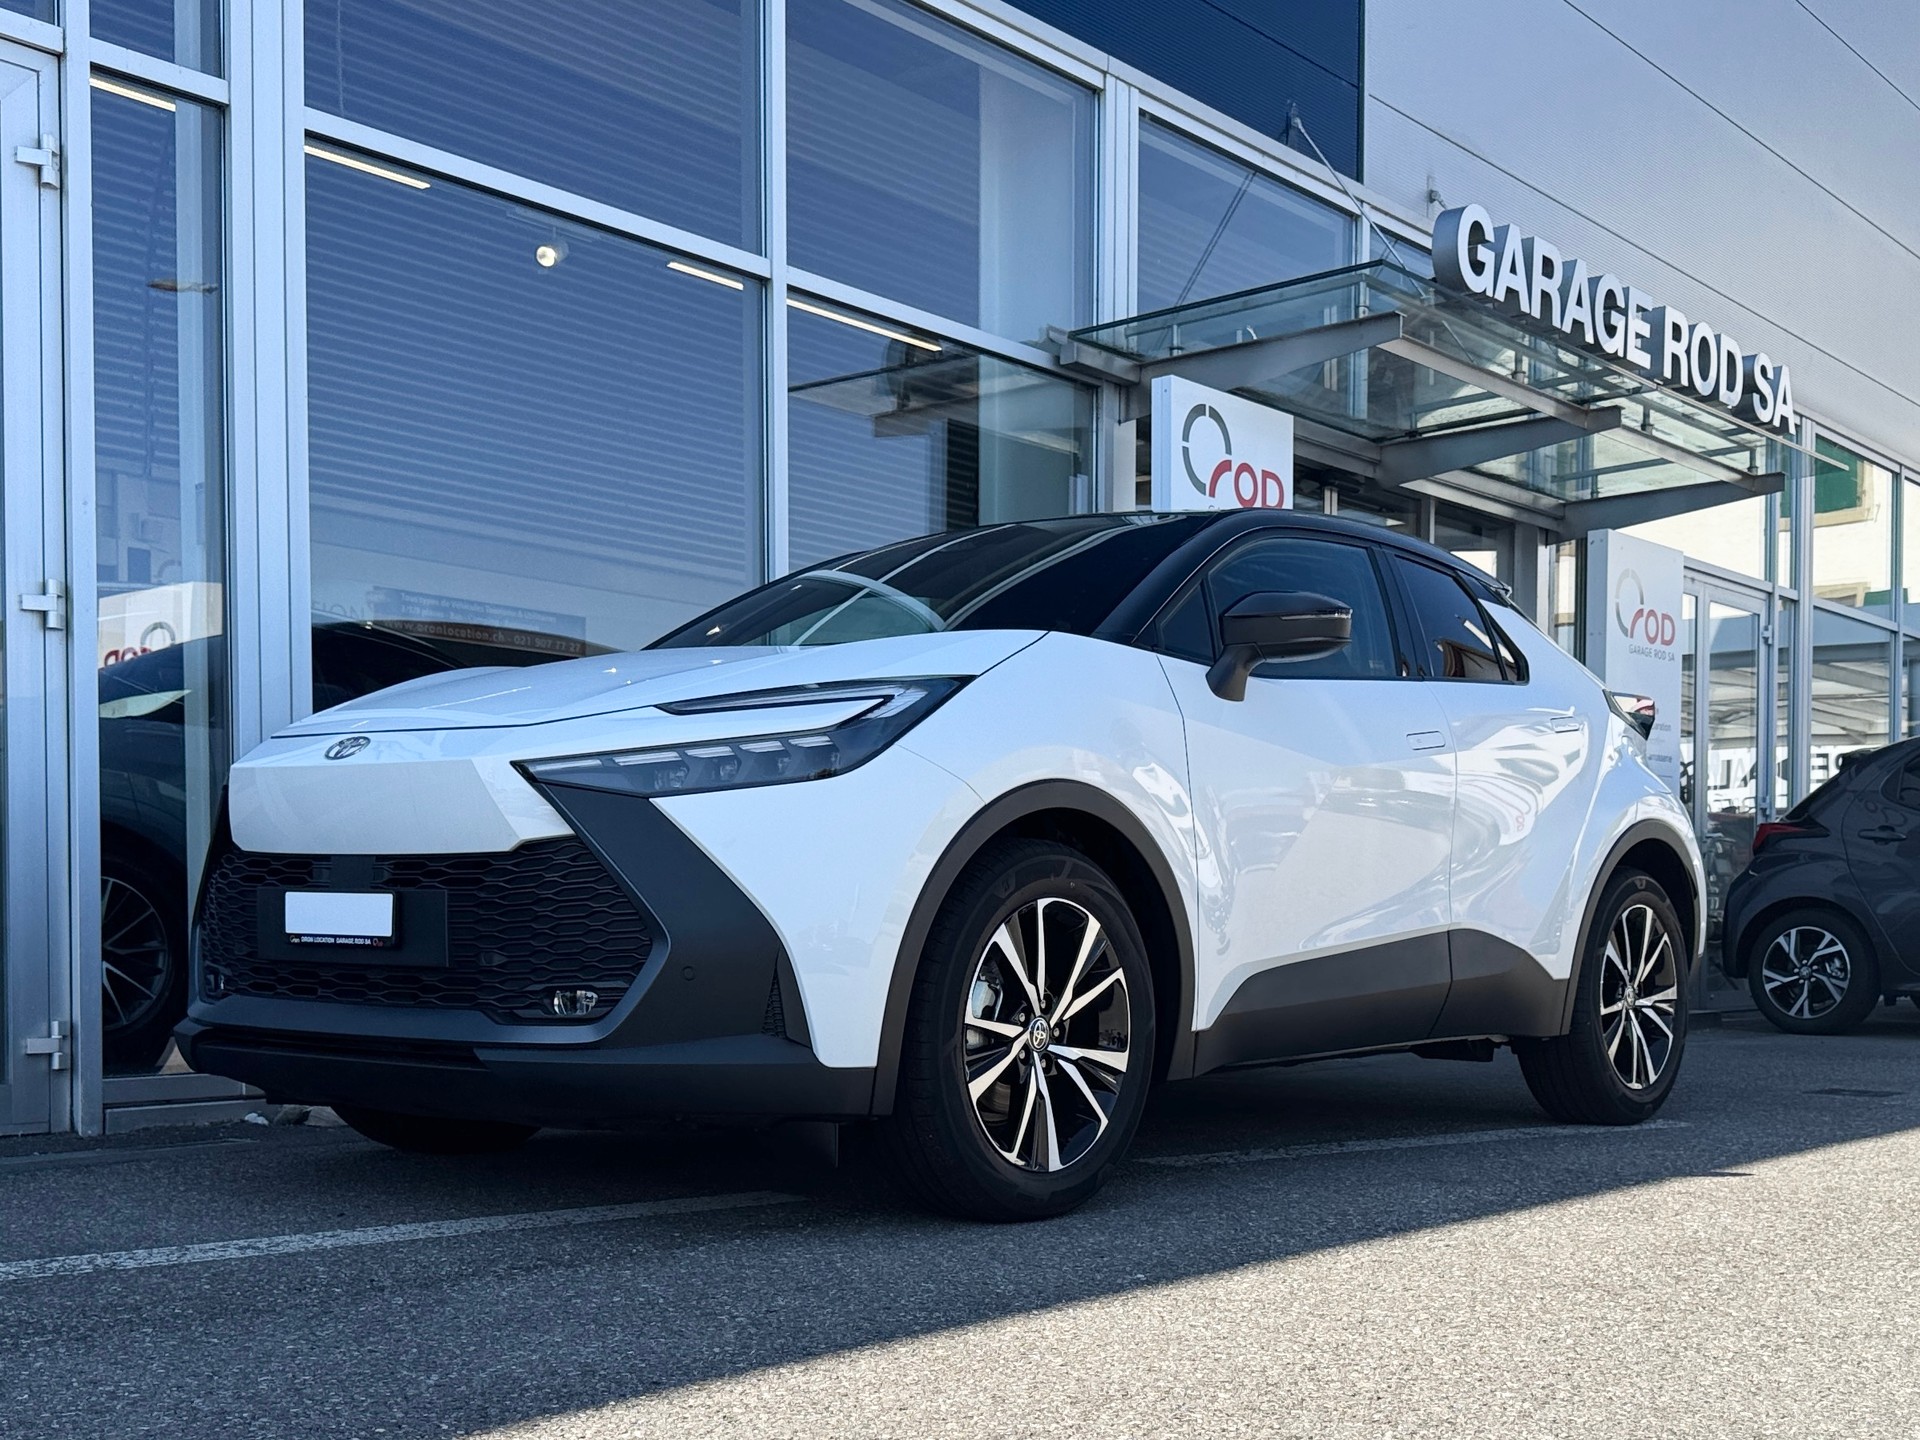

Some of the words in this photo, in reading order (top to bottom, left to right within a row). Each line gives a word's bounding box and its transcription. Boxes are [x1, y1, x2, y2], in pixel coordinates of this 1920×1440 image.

[1457, 203, 1652, 369] GARAGE
[1663, 305, 1744, 408] ROD
[1752, 352, 1796, 435] SA
[513, 634, 532, 646] 021
[1628, 644, 1652, 658] GARAGE
[1654, 649, 1667, 661] ROD
[1668, 651, 1675, 662] SA
